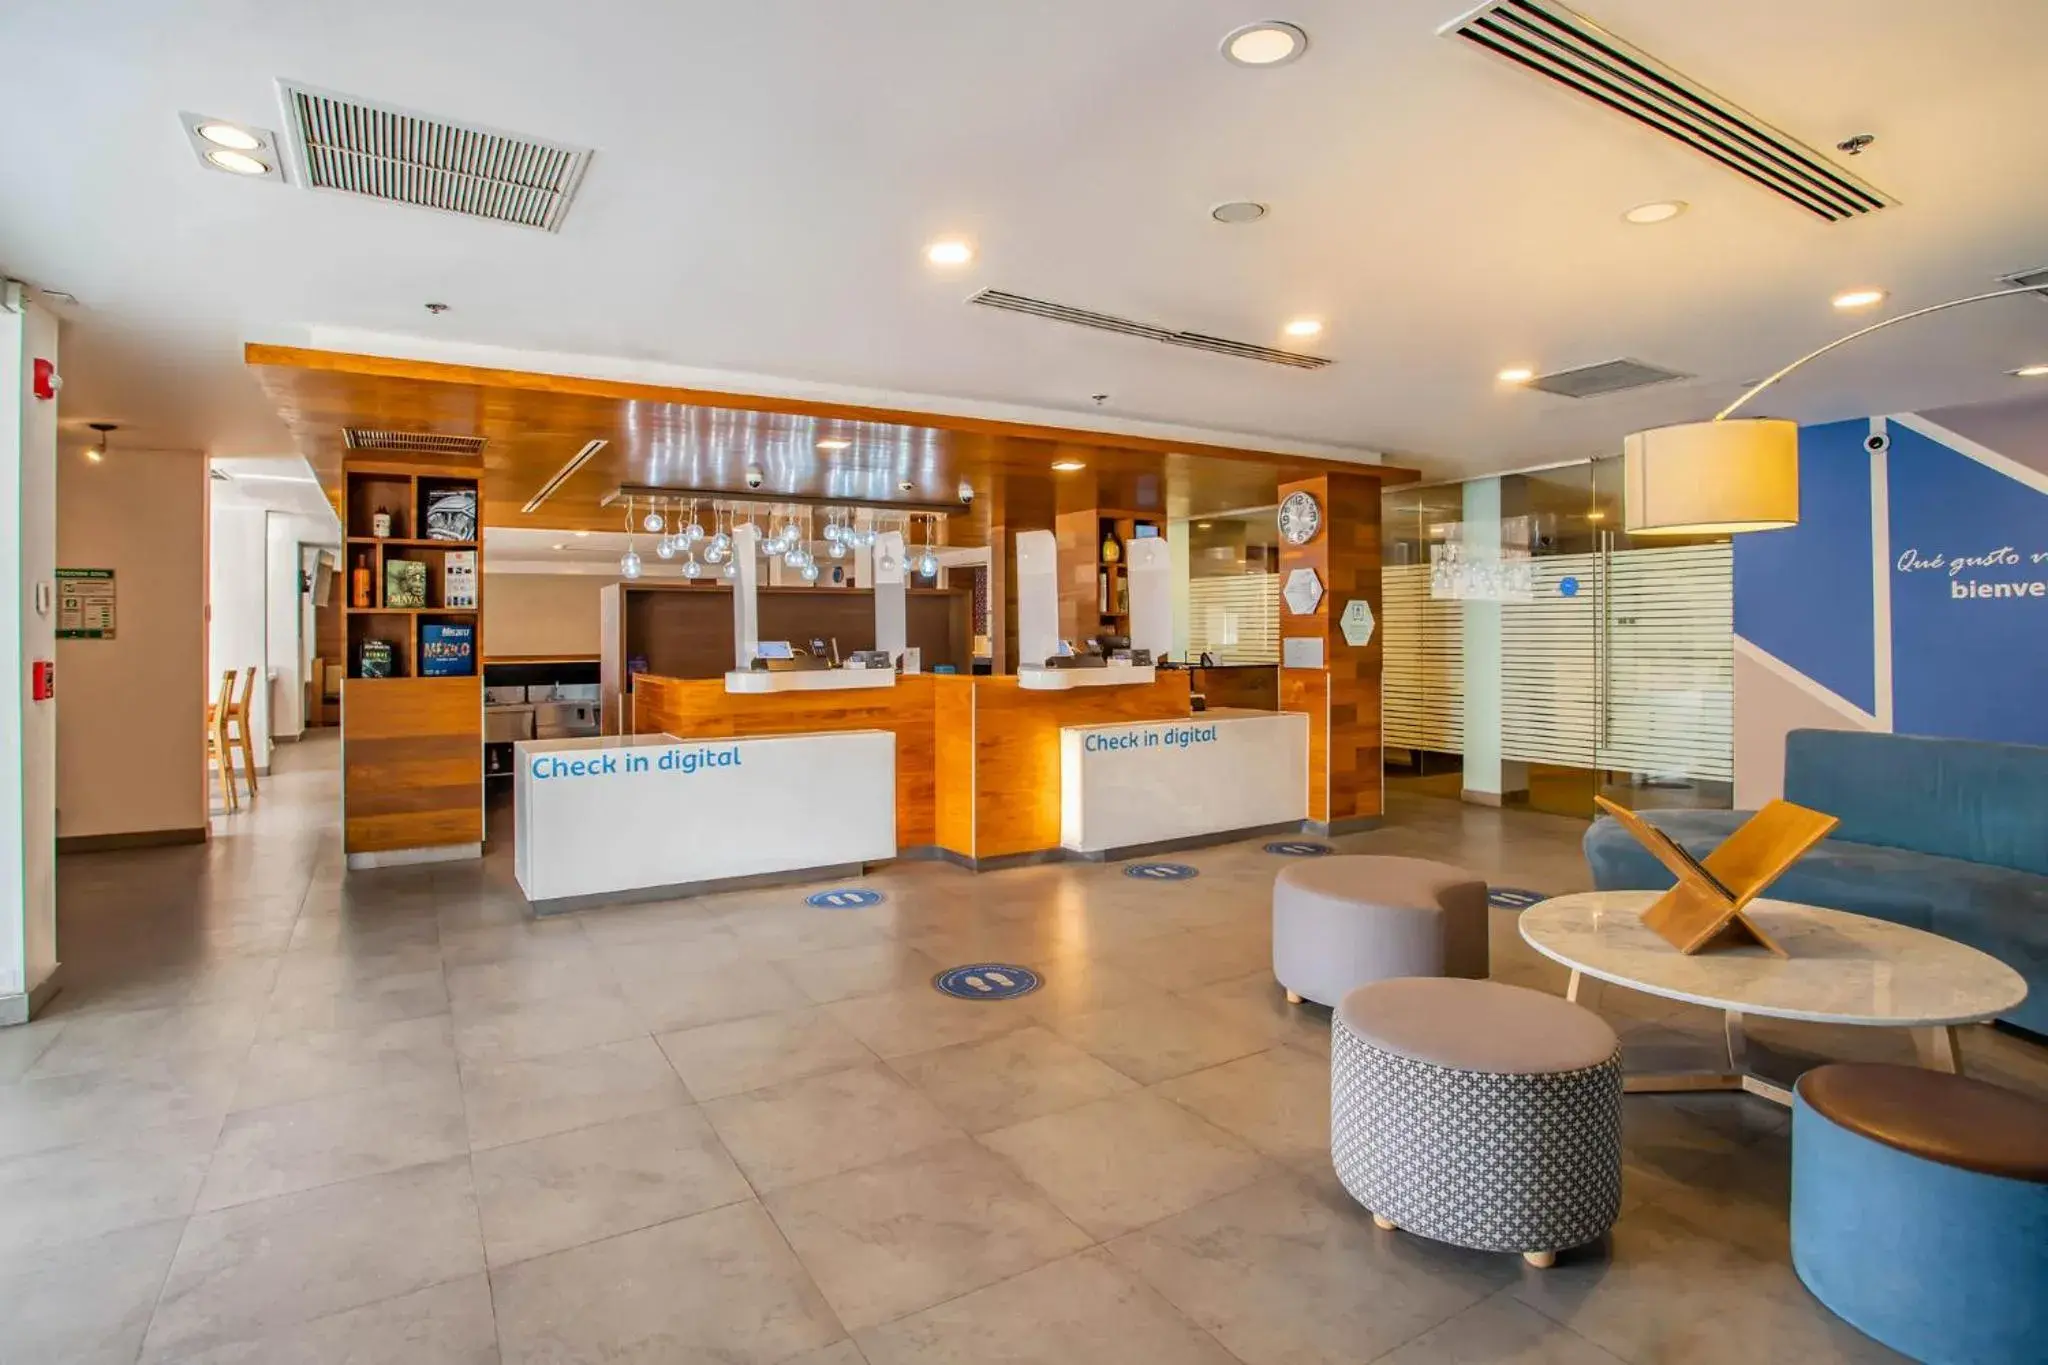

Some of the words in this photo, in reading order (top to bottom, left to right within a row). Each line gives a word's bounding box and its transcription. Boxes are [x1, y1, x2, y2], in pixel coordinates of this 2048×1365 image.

[1897, 548, 1946, 573] Qué
[1949, 546, 2020, 577] gusto
[1951, 580, 2048, 599] bienve
[1084, 731, 1139, 752] Check
[1144, 730, 1159, 746] in
[1164, 725, 1218, 748] digital
[532, 754, 617, 779] Check
[626, 753, 649, 772] in
[658, 746, 742, 774] digital
